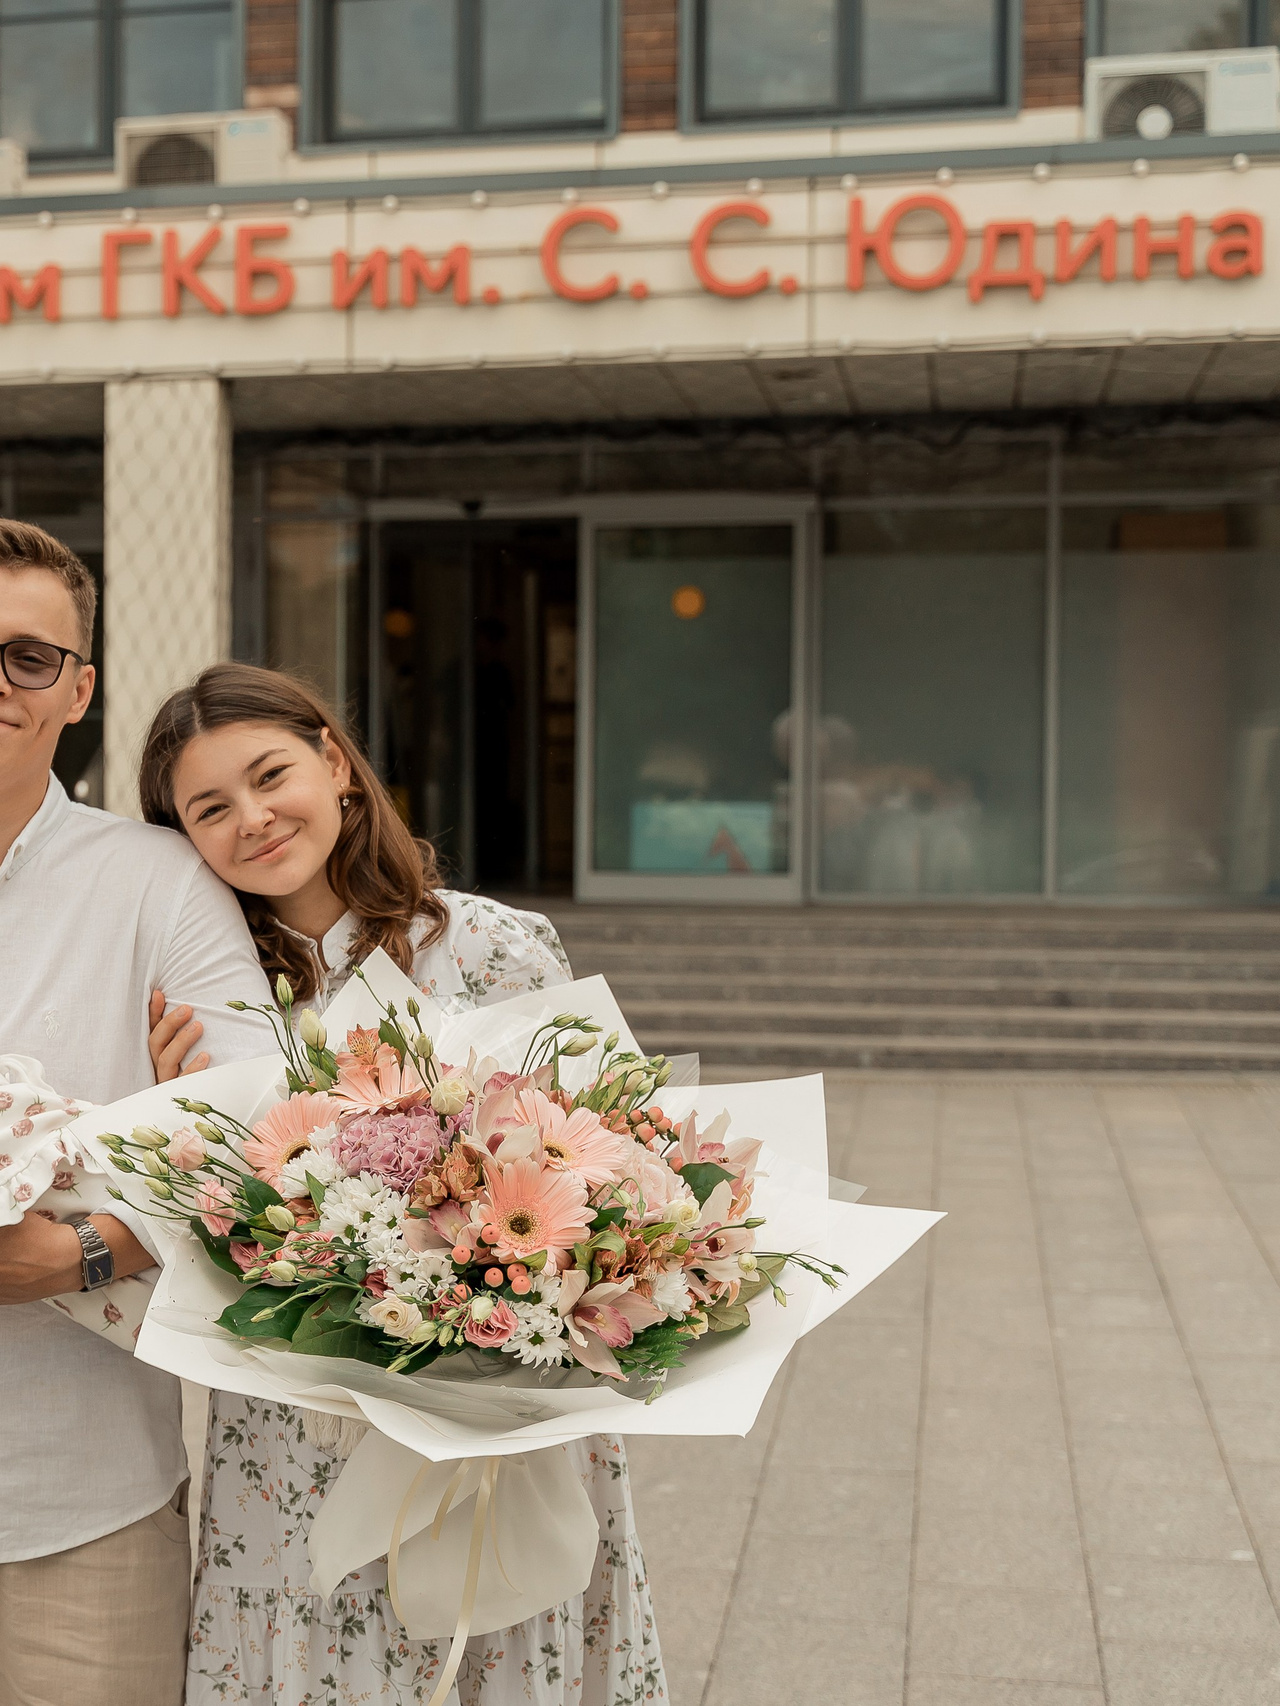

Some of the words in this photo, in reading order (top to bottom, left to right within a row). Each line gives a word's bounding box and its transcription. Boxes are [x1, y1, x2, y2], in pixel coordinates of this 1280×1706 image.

[99, 223, 297, 322] ГКБ
[330, 244, 502, 312] им.
[538, 207, 650, 303] С.
[688, 201, 799, 299] С.
[844, 193, 1265, 304] Юдина
